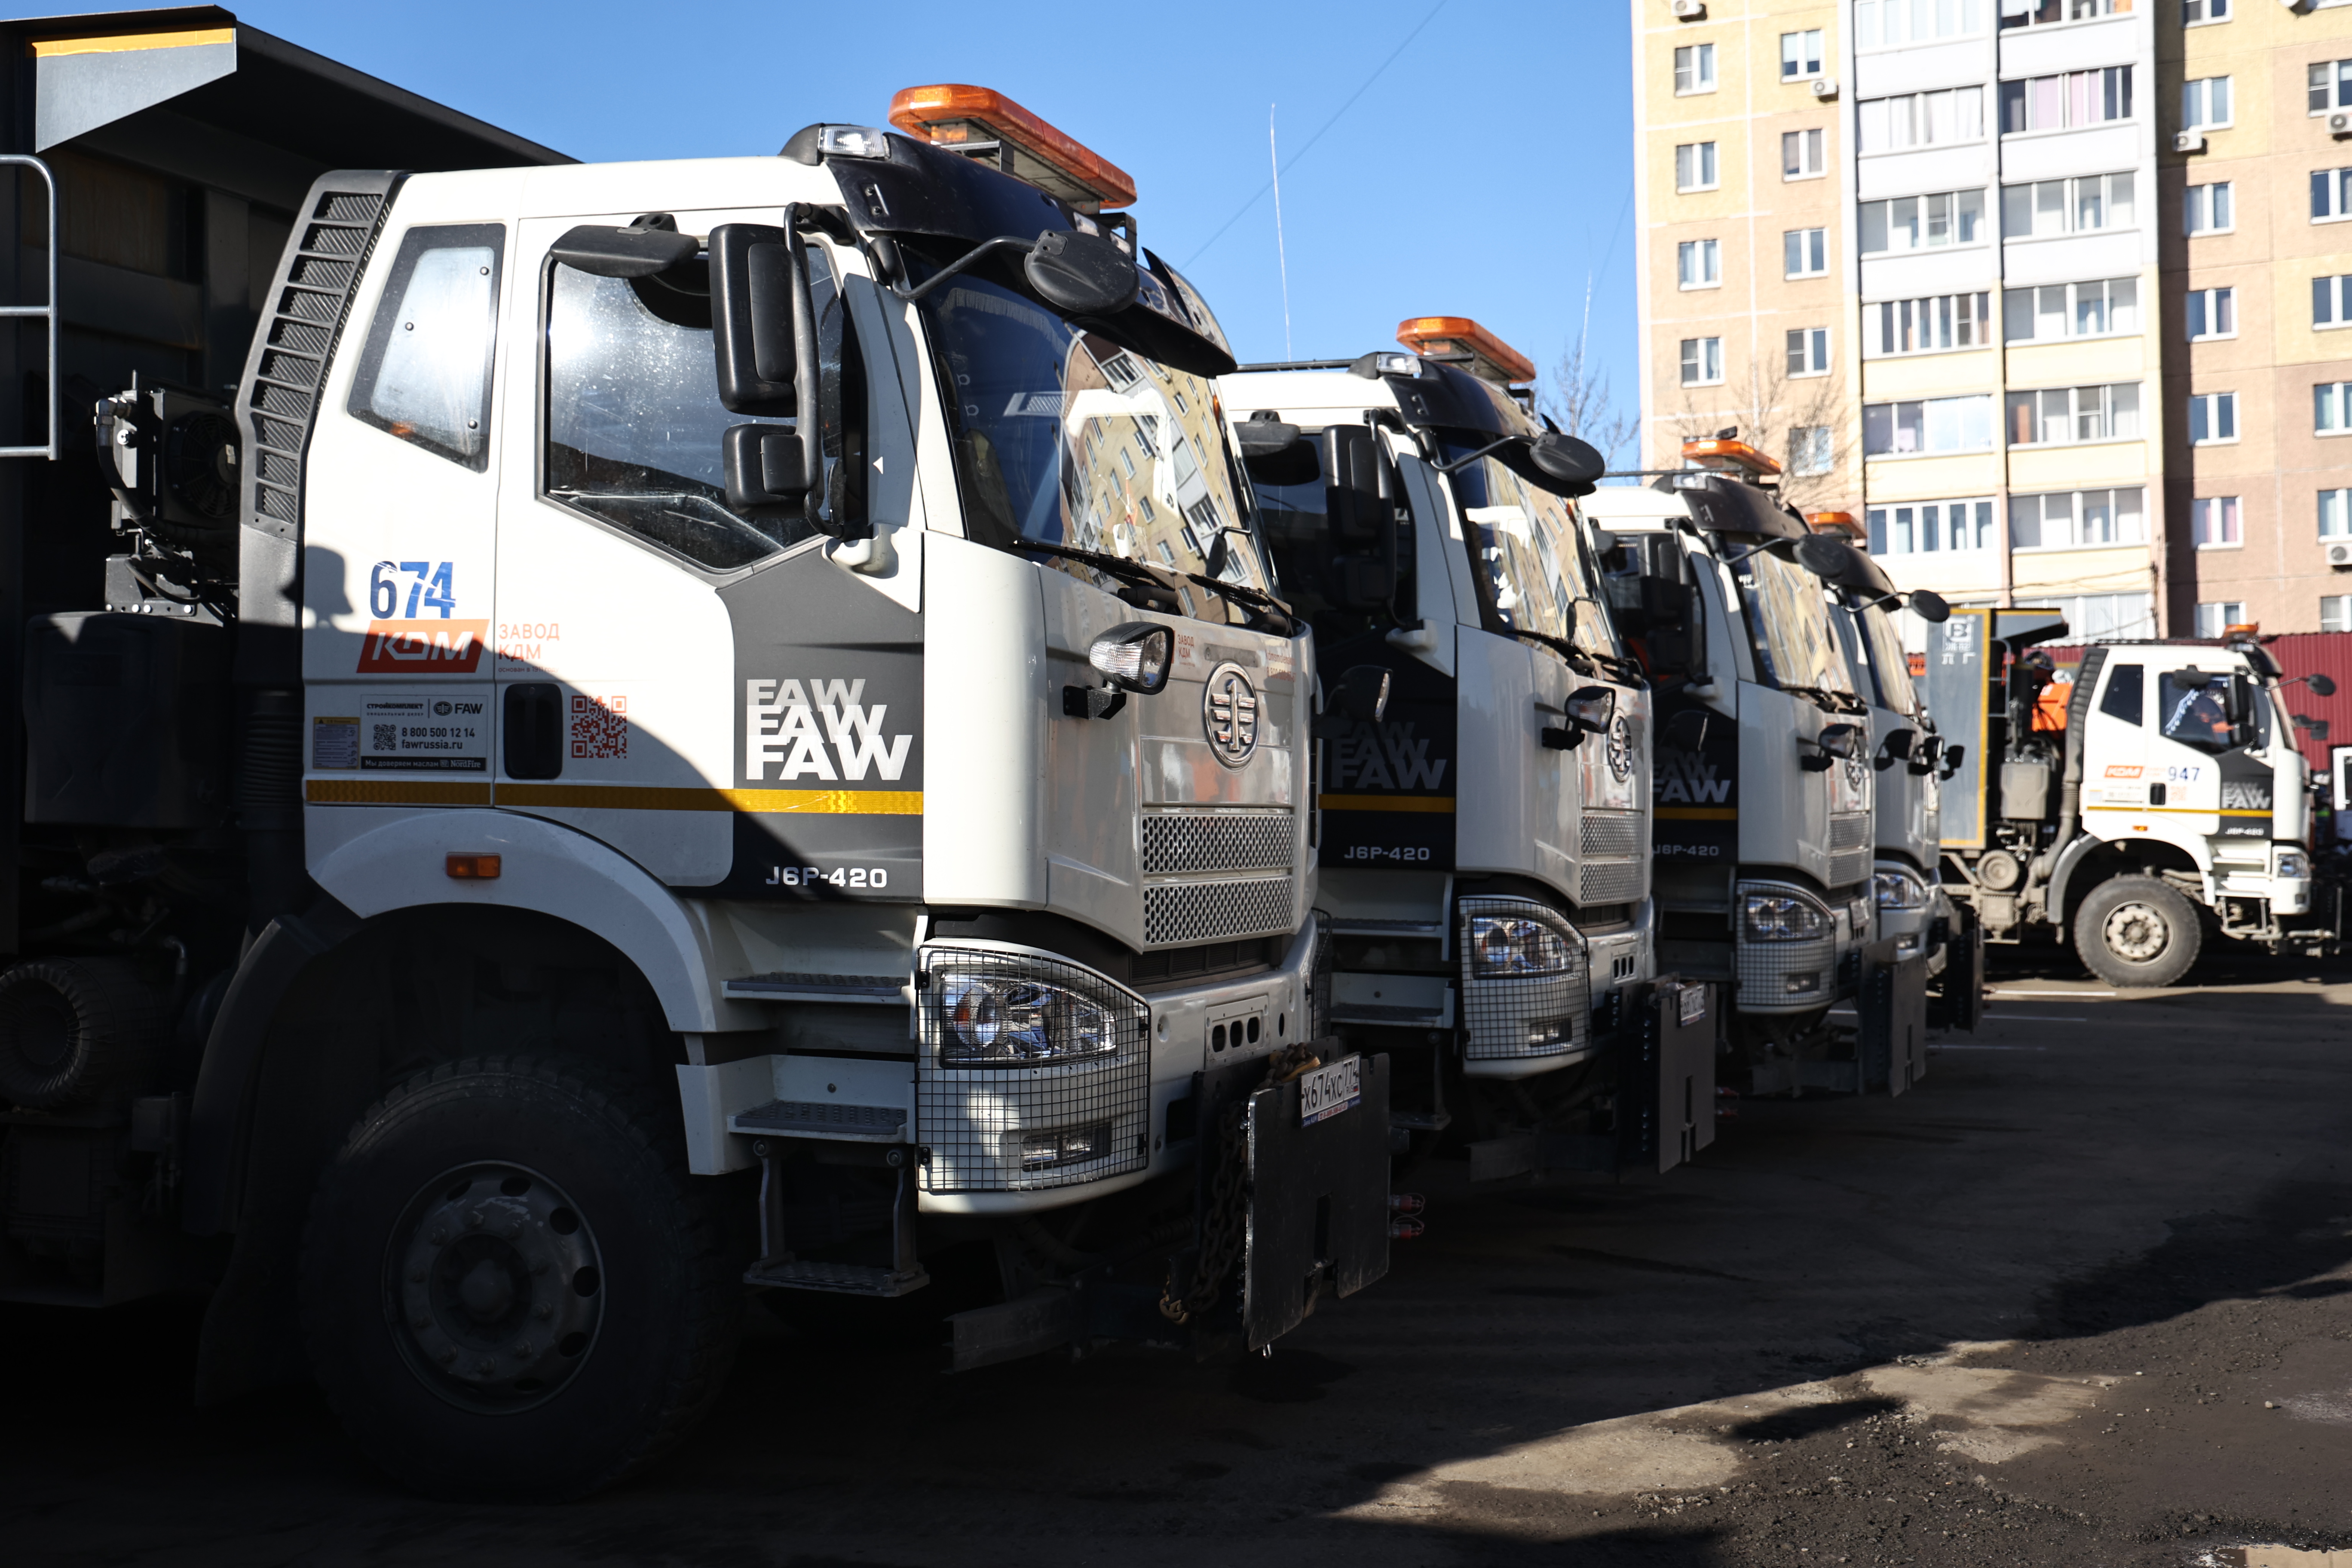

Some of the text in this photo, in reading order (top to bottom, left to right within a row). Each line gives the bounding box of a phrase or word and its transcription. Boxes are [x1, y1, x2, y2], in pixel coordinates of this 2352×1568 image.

[370, 560, 456, 619] 674
[499, 623, 560, 641] ЗАВОД
[1177, 634, 1194, 647] ЗАВОД
[499, 644, 541, 662] КДМ
[1178, 647, 1191, 658] КДМ
[455, 704, 483, 714] FAW
[402, 728, 475, 738] 8 800 500 12 14
[402, 739, 463, 749] fawrussia.ru
[450, 760, 481, 768] NordFire
[747, 735, 913, 780] FAW
[1331, 759, 1447, 789] FAW
[2168, 766, 2200, 781] 947
[2221, 796, 2272, 809] FAW
[1344, 846, 1430, 861] J6P-420
[765, 867, 888, 888] J6P-420
